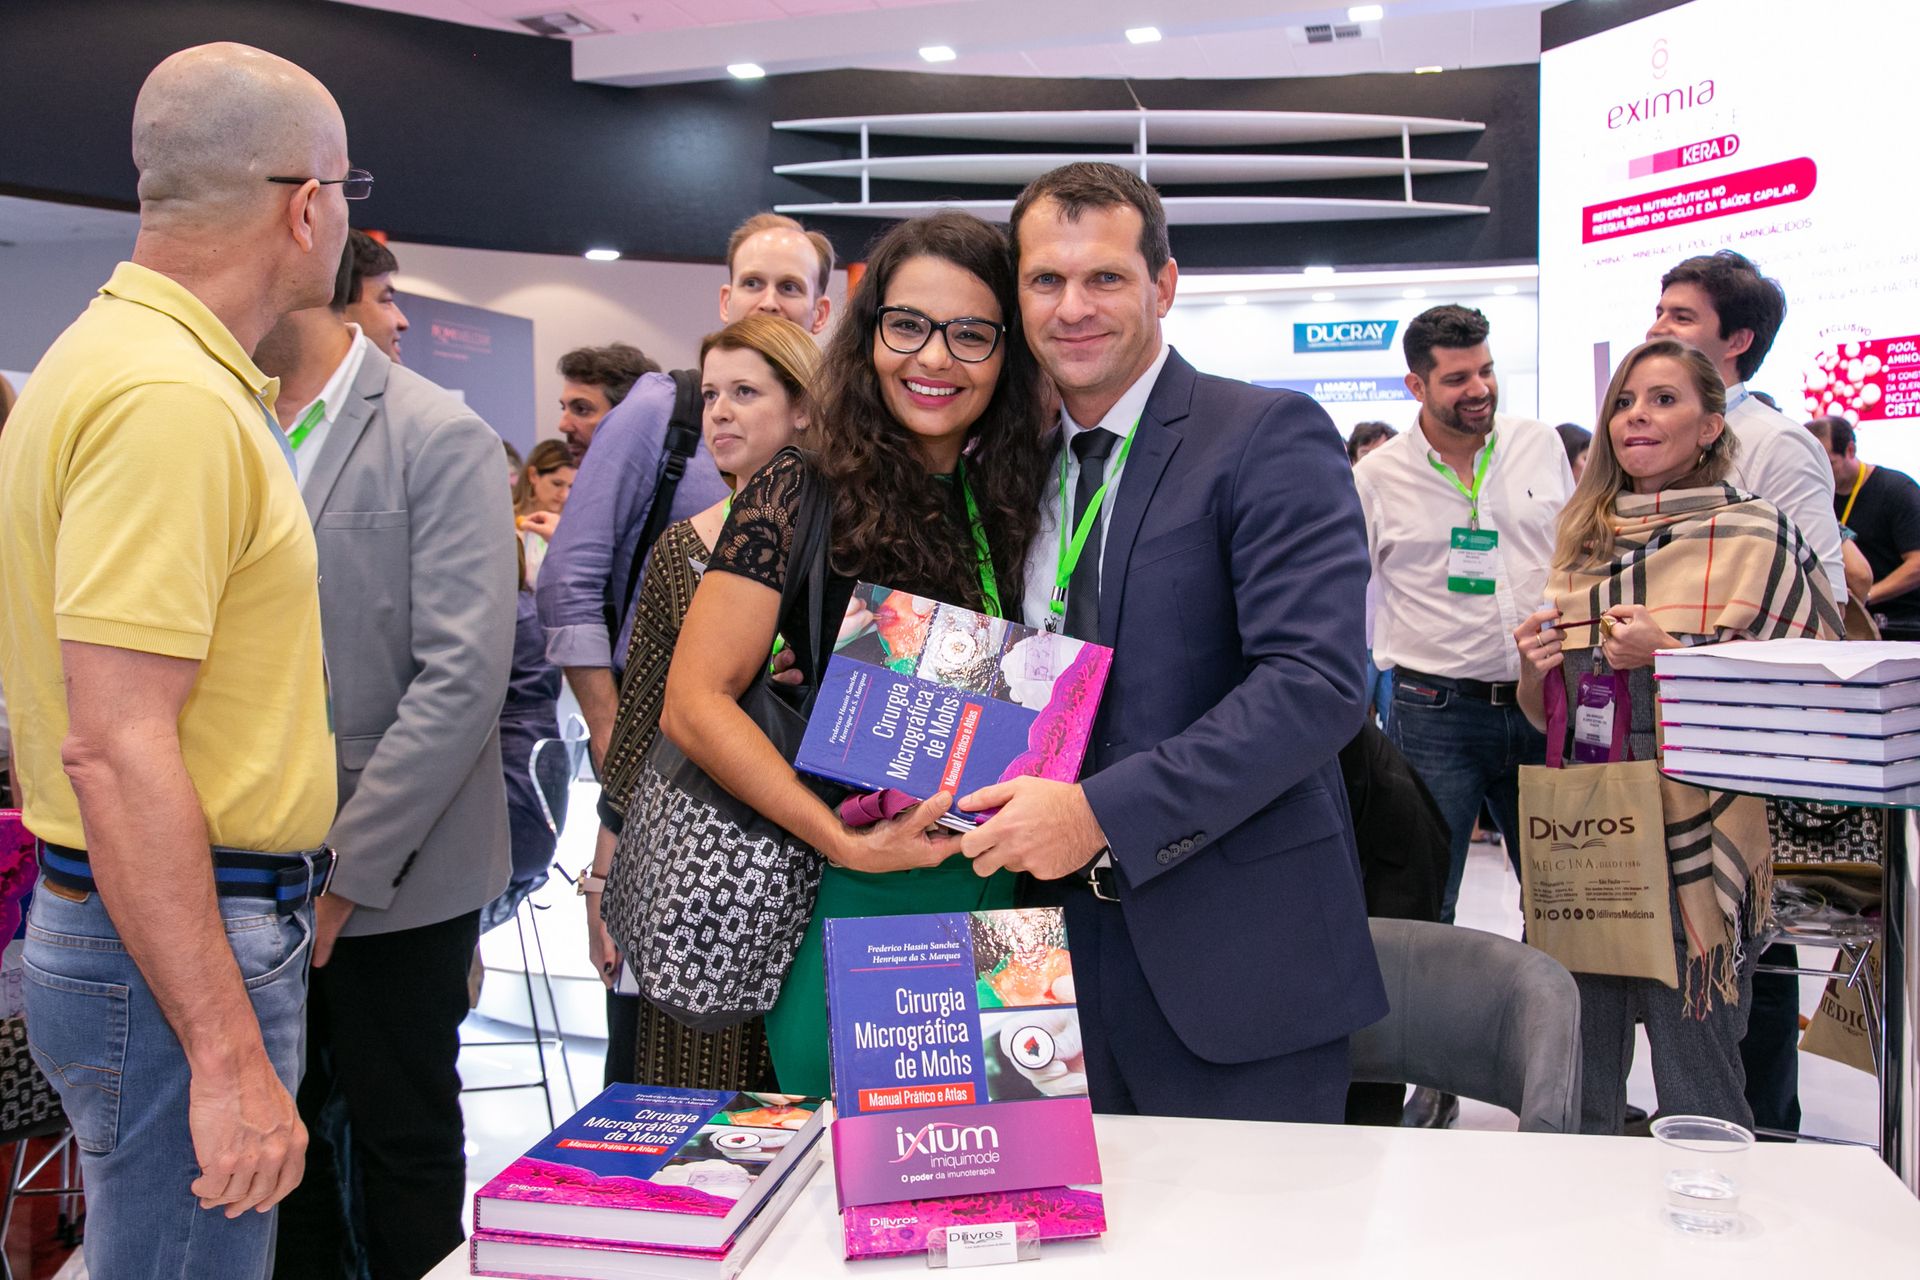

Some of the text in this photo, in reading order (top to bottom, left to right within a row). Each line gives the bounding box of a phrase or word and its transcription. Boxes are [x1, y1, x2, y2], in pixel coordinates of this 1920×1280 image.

[1608, 79, 1715, 129] eximia
[1682, 136, 1738, 165] KERA D
[1592, 185, 1726, 223] REFERÊNCIA NUTRACÊUTICA NO
[1651, 211, 1666, 224] DO
[1667, 205, 1694, 221] CICLO
[1695, 203, 1703, 215] E
[1704, 200, 1718, 213] DA
[1720, 193, 1751, 209] SAÚDE
[1306, 322, 1387, 343] DUCRAY
[1887, 341, 1917, 354] POOL
[1887, 352, 1920, 364] AMINO
[1886, 383, 1896, 392] DA
[829, 670, 859, 744] Frederico Hassin Sanchez
[839, 714, 853, 743] Henrique
[849, 706, 856, 715] da
[854, 672, 868, 699] Marques
[872, 682, 910, 739] Cirurgia
[886, 690, 935, 780] Micrográfica
[923, 696, 960, 759] de Mohs
[944, 759, 962, 787] Manual
[953, 734, 971, 760] Prático
[963, 710, 979, 729] Atlas
[867, 940, 960, 954] Frederico Hassin Sanchez
[872, 952, 960, 964] Henrique da S. Marques
[895, 987, 966, 1018] Cirurgia
[854, 1017, 970, 1051] Micrográfica
[895, 1049, 972, 1080] de Mohs
[868, 1087, 968, 1107] Manual Prático e Atlas
[583, 1116, 689, 1134] Micrográfica
[634, 1109, 700, 1124] Cirurgia
[567, 1140, 600, 1149] Manual
[599, 1142, 629, 1151] Prático
[636, 1145, 658, 1153] Atlas
[603, 1130, 677, 1145] de Mohs
[896, 1123, 999, 1160] ixium
[930, 1150, 1000, 1169] imiquimode
[901, 1167, 996, 1184] O poder da imunoterapia
